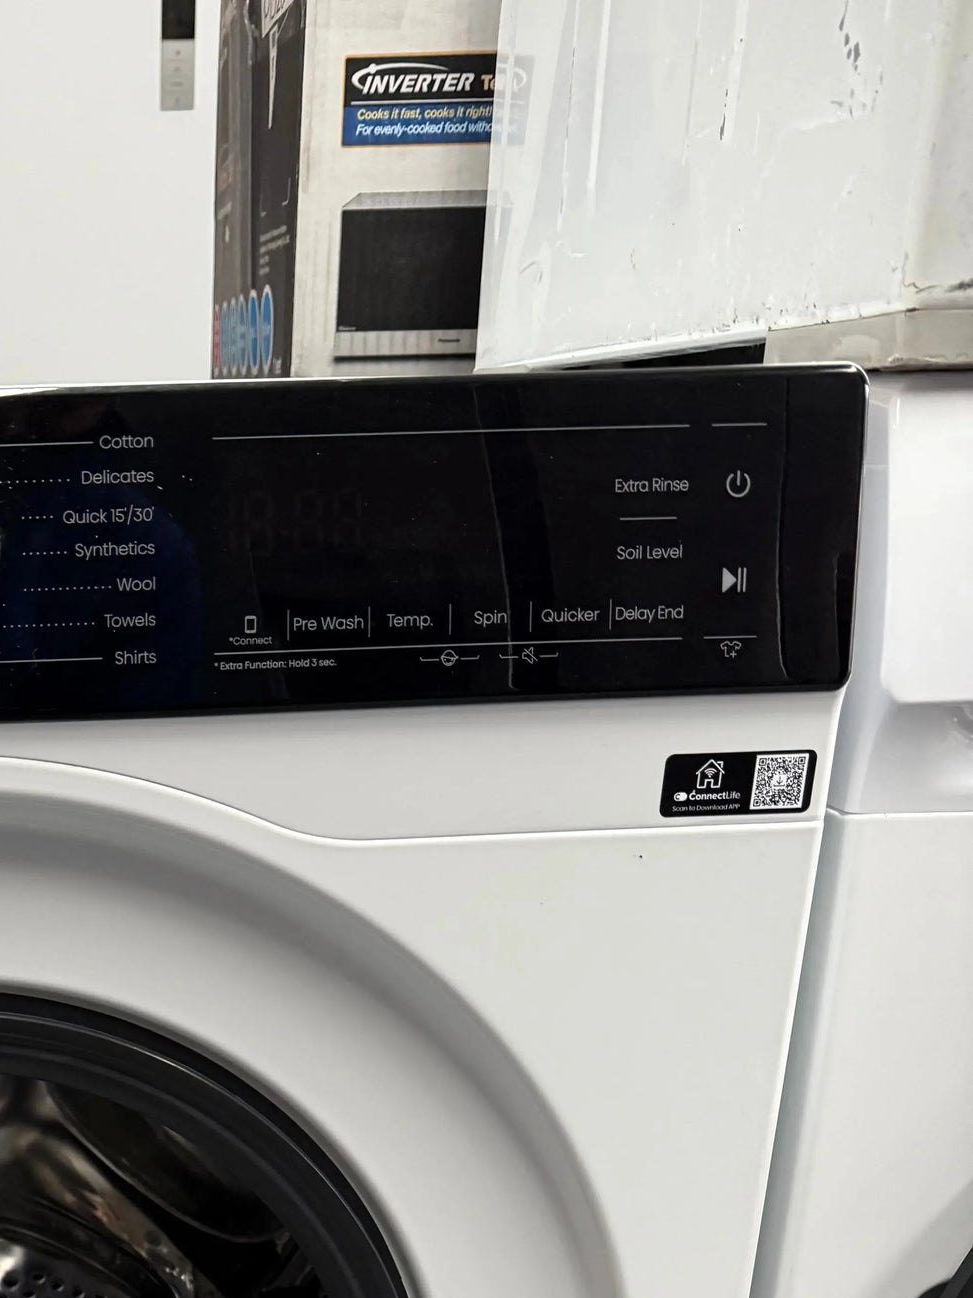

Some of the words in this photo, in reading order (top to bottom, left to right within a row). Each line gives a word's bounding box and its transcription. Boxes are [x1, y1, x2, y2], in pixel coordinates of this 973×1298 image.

[362, 72, 476, 95] INVERTER
[357, 108, 389, 121] Cooks
[390, 107, 398, 119] it
[399, 107, 423, 120] fast,
[424, 106, 455, 118] cooks
[456, 106, 464, 118] it
[355, 123, 374, 136] For
[374, 121, 443, 137] evenly-cooked
[443, 120, 467, 134] food
[99, 434, 154, 449] Cotton
[81, 470, 155, 485] Delicates
[615, 478, 649, 493] Extra
[652, 478, 689, 492] Rinse
[62, 509, 107, 525] Quick
[75, 541, 156, 561] Synthetics
[616, 545, 642, 560] Soil
[646, 544, 683, 559] Level
[116, 576, 156, 592] Wool
[104, 612, 157, 629] Towels
[386, 613, 434, 630] Temp.
[473, 609, 508, 628] Spin
[541, 608, 600, 623] Quicker
[615, 606, 656, 623] Delay
[657, 605, 684, 619] End
[293, 617, 318, 631] Pre
[320, 615, 364, 630] Wash
[114, 650, 157, 665] Shirts
[220, 661, 243, 670] Extra
[244, 660, 287, 669] Function:
[288, 658, 310, 668] Hold
[311, 658, 317, 667] 3
[318, 658, 337, 667] sec.
[689, 791, 741, 800] ConnectLife
